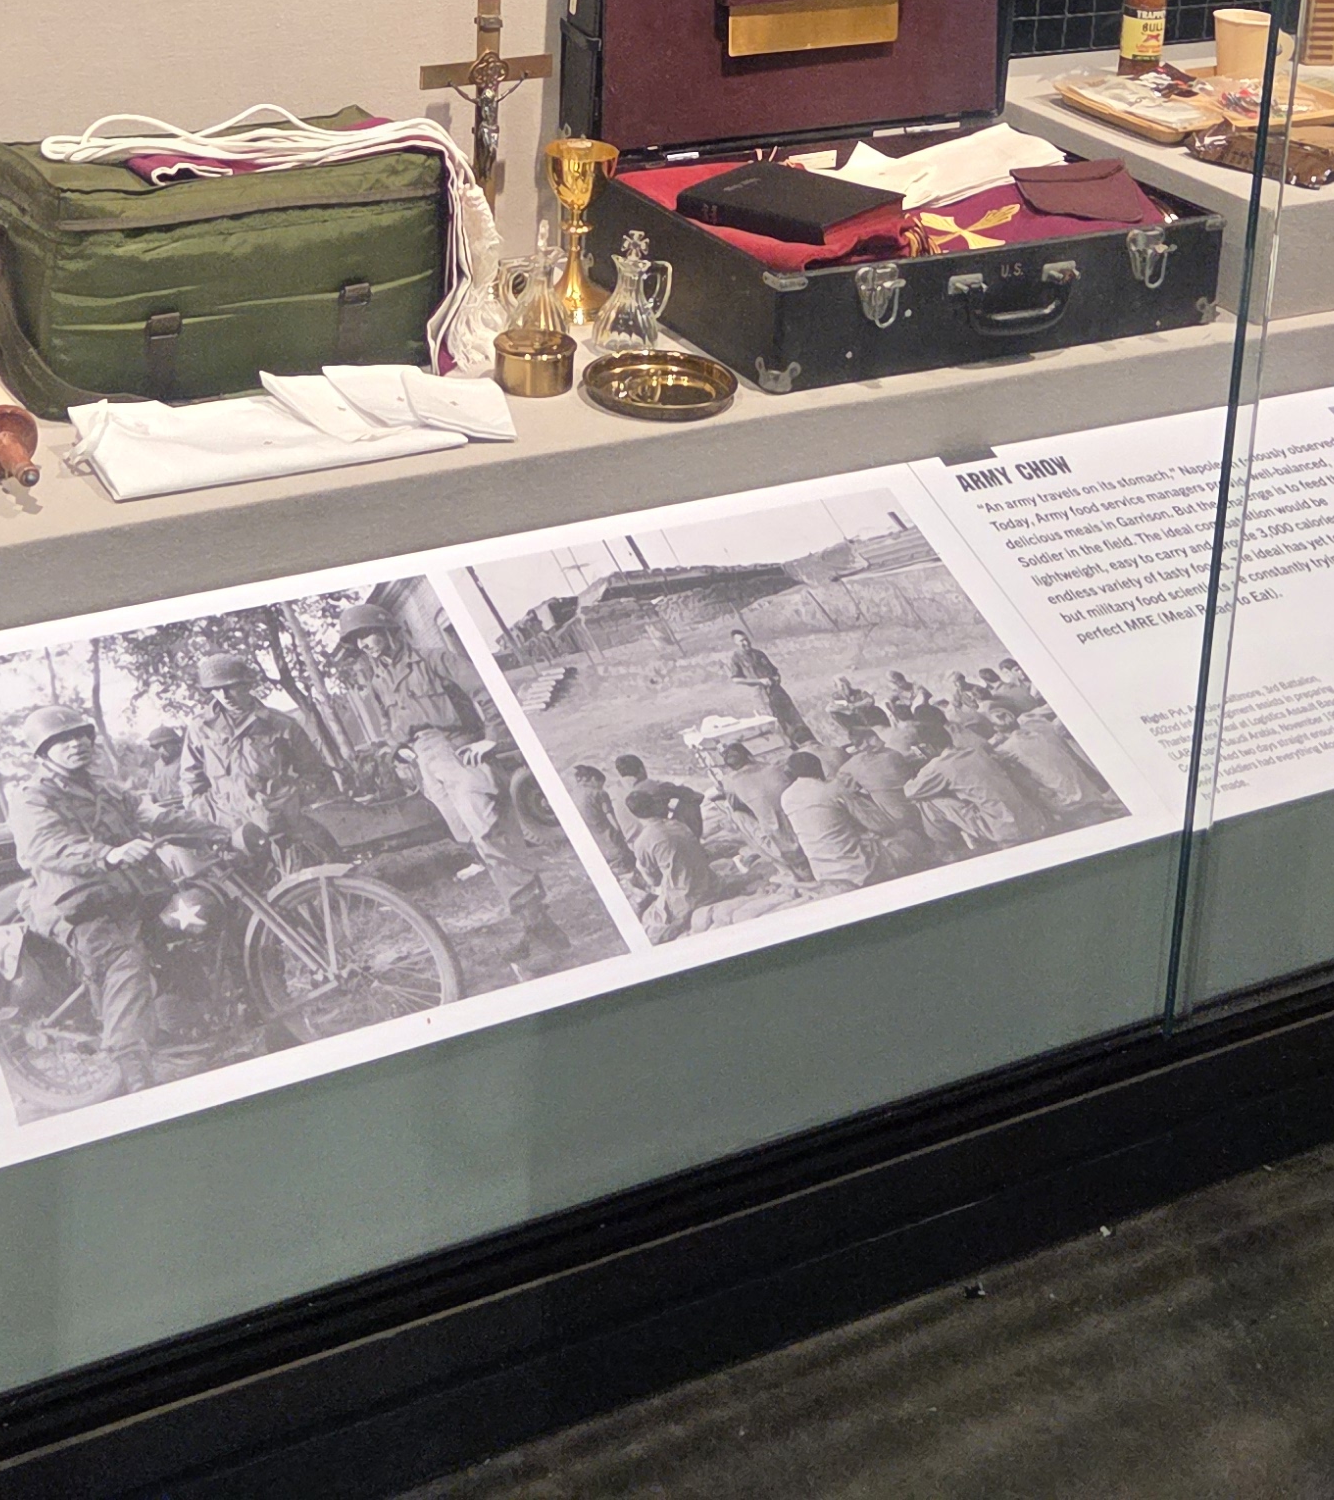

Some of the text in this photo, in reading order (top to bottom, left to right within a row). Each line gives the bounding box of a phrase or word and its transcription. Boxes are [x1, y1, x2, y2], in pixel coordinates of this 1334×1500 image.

[1001, 262, 1024, 278] U.S.
[955, 456, 1072, 493] ARMY CHOW
[1271, 486, 1287, 496] is
[1284, 483, 1301, 493] to
[1298, 476, 1328, 490] feed
[989, 484, 1206, 532] Today, Army food service managers
[1004, 496, 1038, 510] army
[1036, 487, 1082, 503] travels
[1081, 485, 1100, 495] on
[1096, 481, 1117, 491] its
[1005, 531, 1064, 550] delicious
[1063, 522, 1103, 539] meals
[1100, 520, 1118, 531] in
[1115, 510, 1175, 528] Garrison.
[1171, 503, 1198, 516] But
[1017, 523, 1195, 568] Soldier in the field. The ideal
